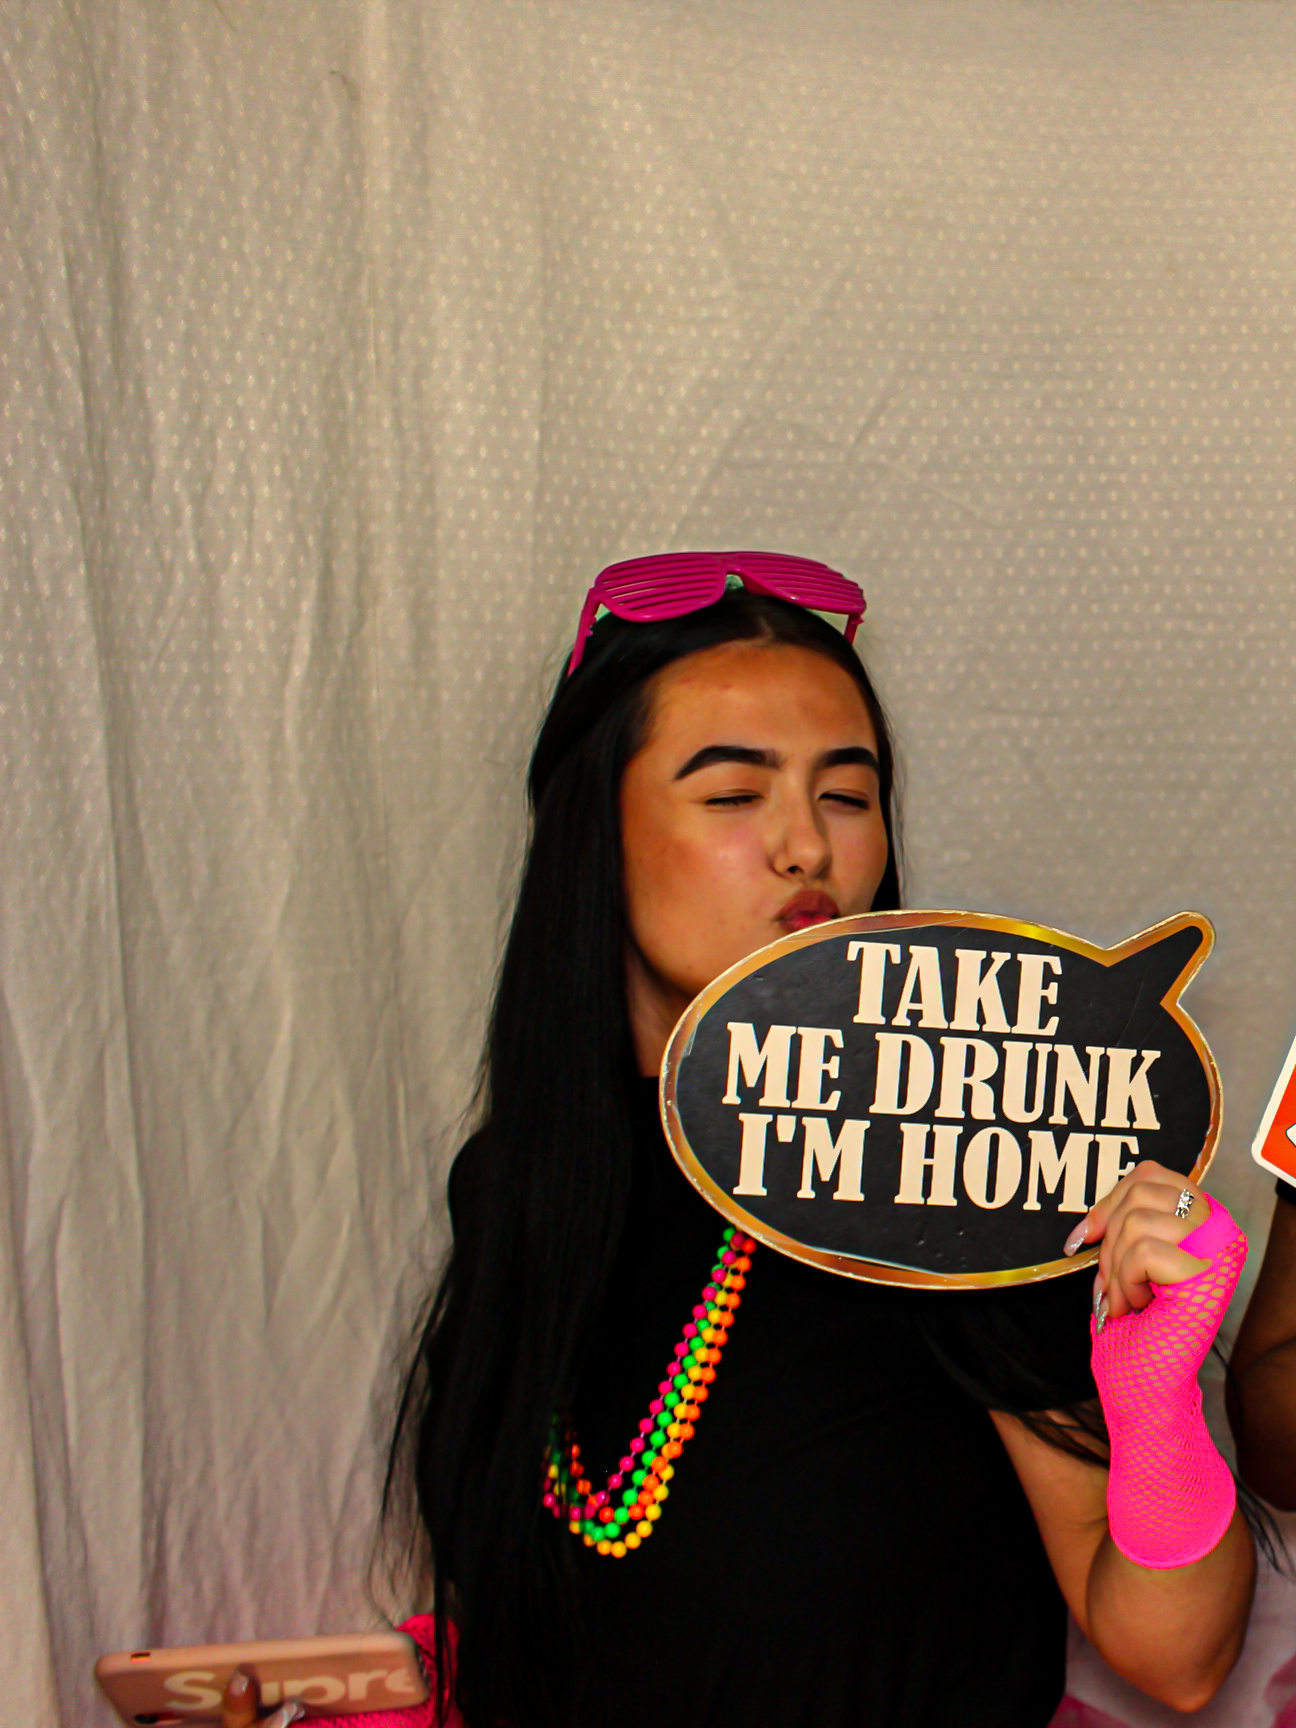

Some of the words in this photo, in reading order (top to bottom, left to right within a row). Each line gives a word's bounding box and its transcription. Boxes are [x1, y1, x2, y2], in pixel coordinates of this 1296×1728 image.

[848, 941, 1062, 1036] TAKE
[722, 1022, 844, 1111] ME
[868, 1032, 1161, 1130] DRUNK
[732, 1112, 871, 1201] I'M
[894, 1122, 1140, 1213] HOME
